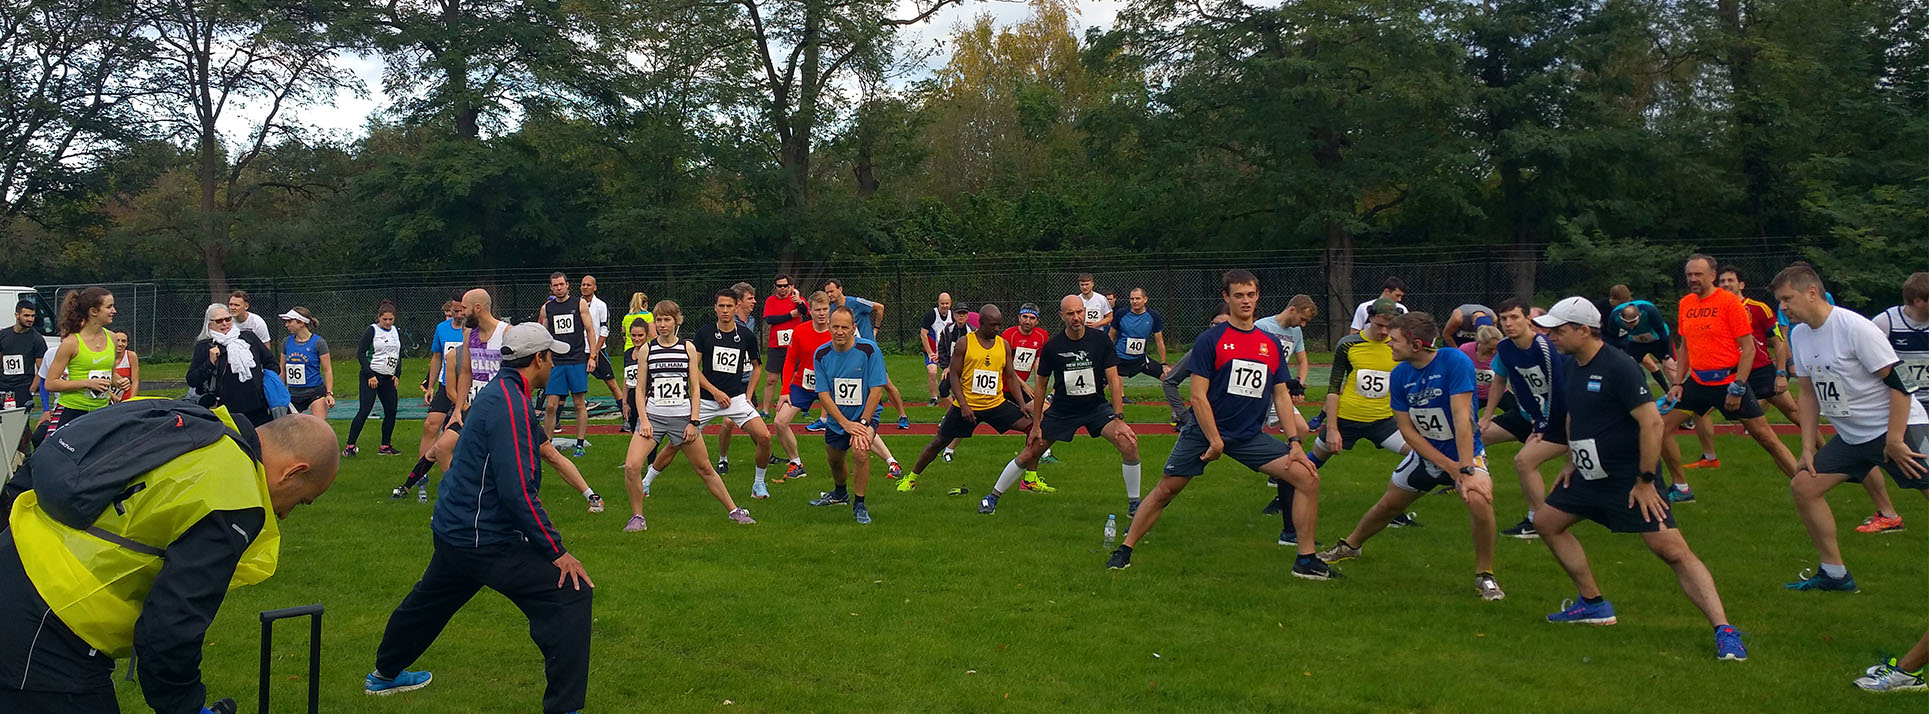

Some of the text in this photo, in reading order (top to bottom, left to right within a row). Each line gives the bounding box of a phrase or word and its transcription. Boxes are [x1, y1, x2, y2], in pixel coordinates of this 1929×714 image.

[1087, 310, 1099, 320] 52
[1686, 307, 1718, 319] GUIDE
[555, 318, 572, 330] 130
[783, 332, 789, 342] 8
[1129, 341, 1143, 351] 40
[387, 356, 397, 368] 155
[716, 351, 737, 367] 162
[1018, 351, 1032, 363] 47
[5, 358, 20, 370] 191
[288, 368, 302, 380] 96
[1235, 367, 1262, 389] 178
[975, 374, 996, 390] 105
[1075, 375, 1086, 388] 4
[1361, 375, 1385, 392] 35
[657, 383, 681, 398] 124
[839, 383, 857, 398] 97
[1815, 381, 1840, 401] 174
[1415, 415, 1443, 432] 54
